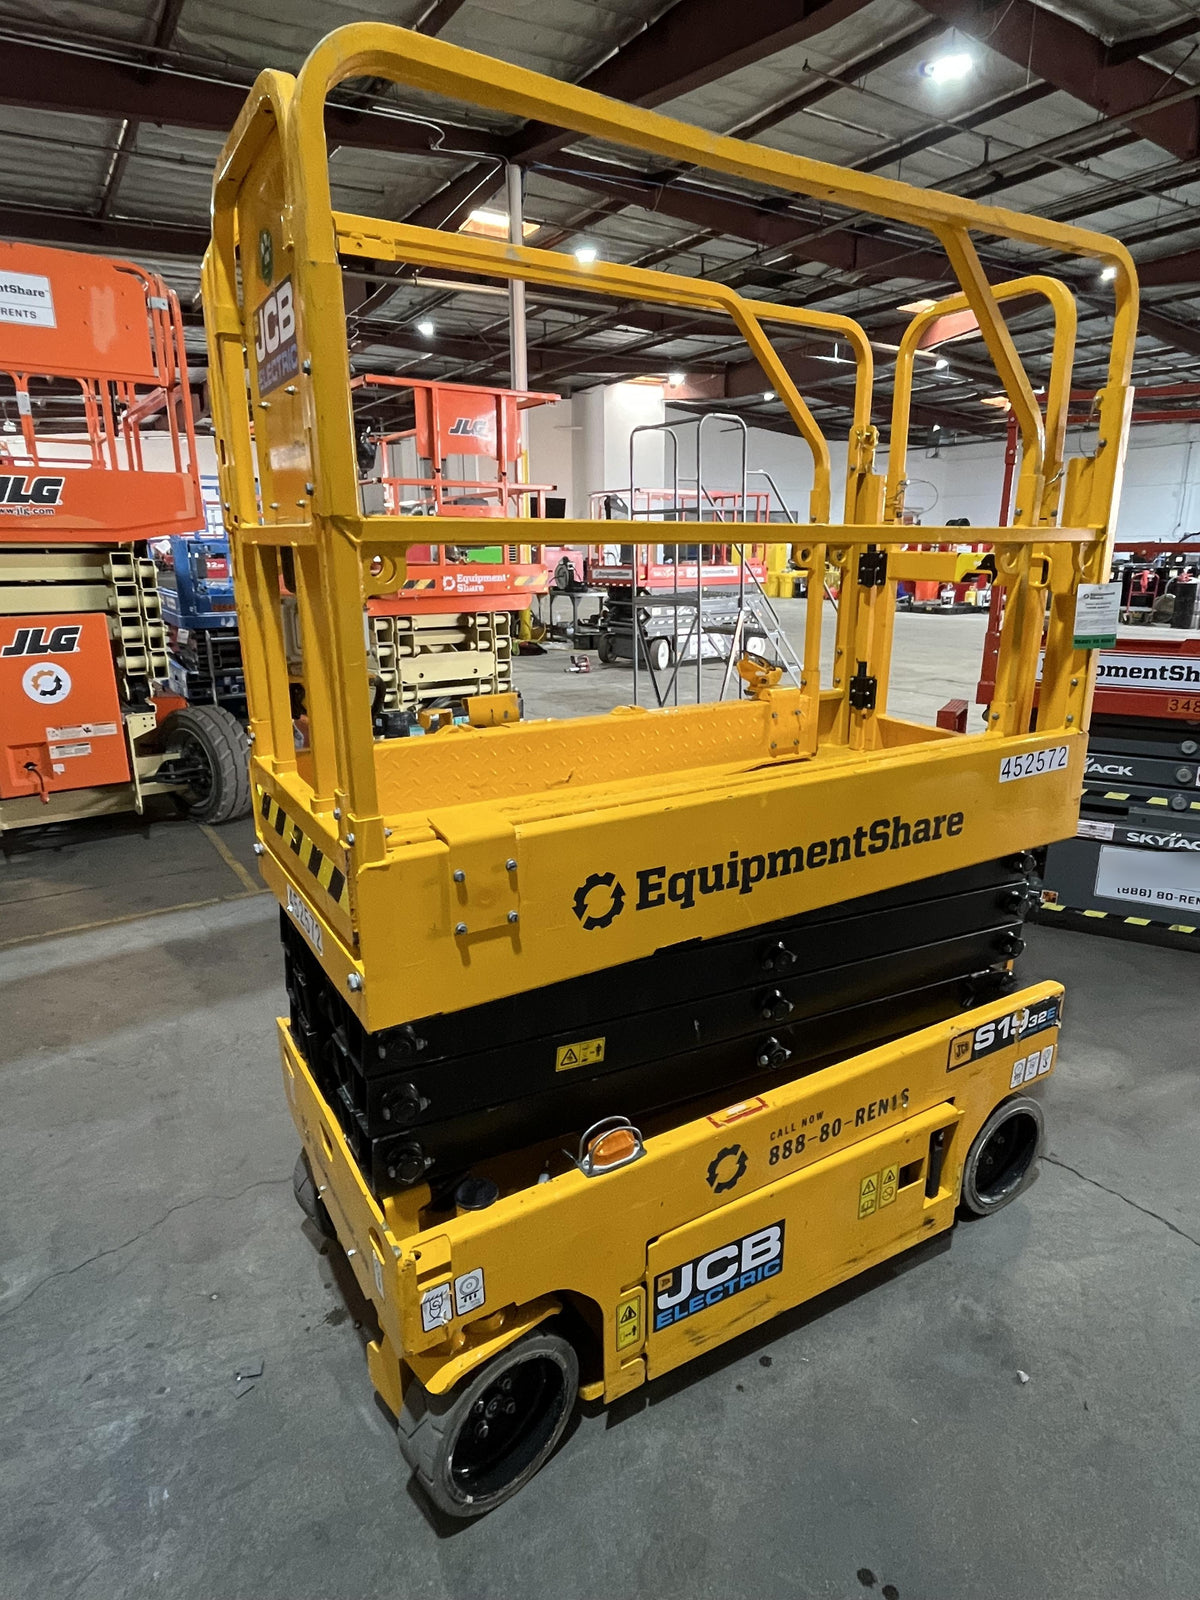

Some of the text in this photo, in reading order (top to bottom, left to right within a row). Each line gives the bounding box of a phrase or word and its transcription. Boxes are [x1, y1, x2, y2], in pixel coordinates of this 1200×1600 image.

[256, 281, 295, 363] JCB
[448, 418, 490, 439] JLG
[456, 574, 507, 585] Equipment
[456, 584, 485, 593] Share
[1, 626, 82, 657] JLG
[1001, 746, 1067, 779] 452572
[635, 811, 964, 911] EquipmentShare
[288, 888, 323, 952] 452572
[770, 1110, 825, 1141] CALL NOW
[657, 1226, 781, 1310] JCB
[656, 1258, 780, 1330] ELECTRIC
